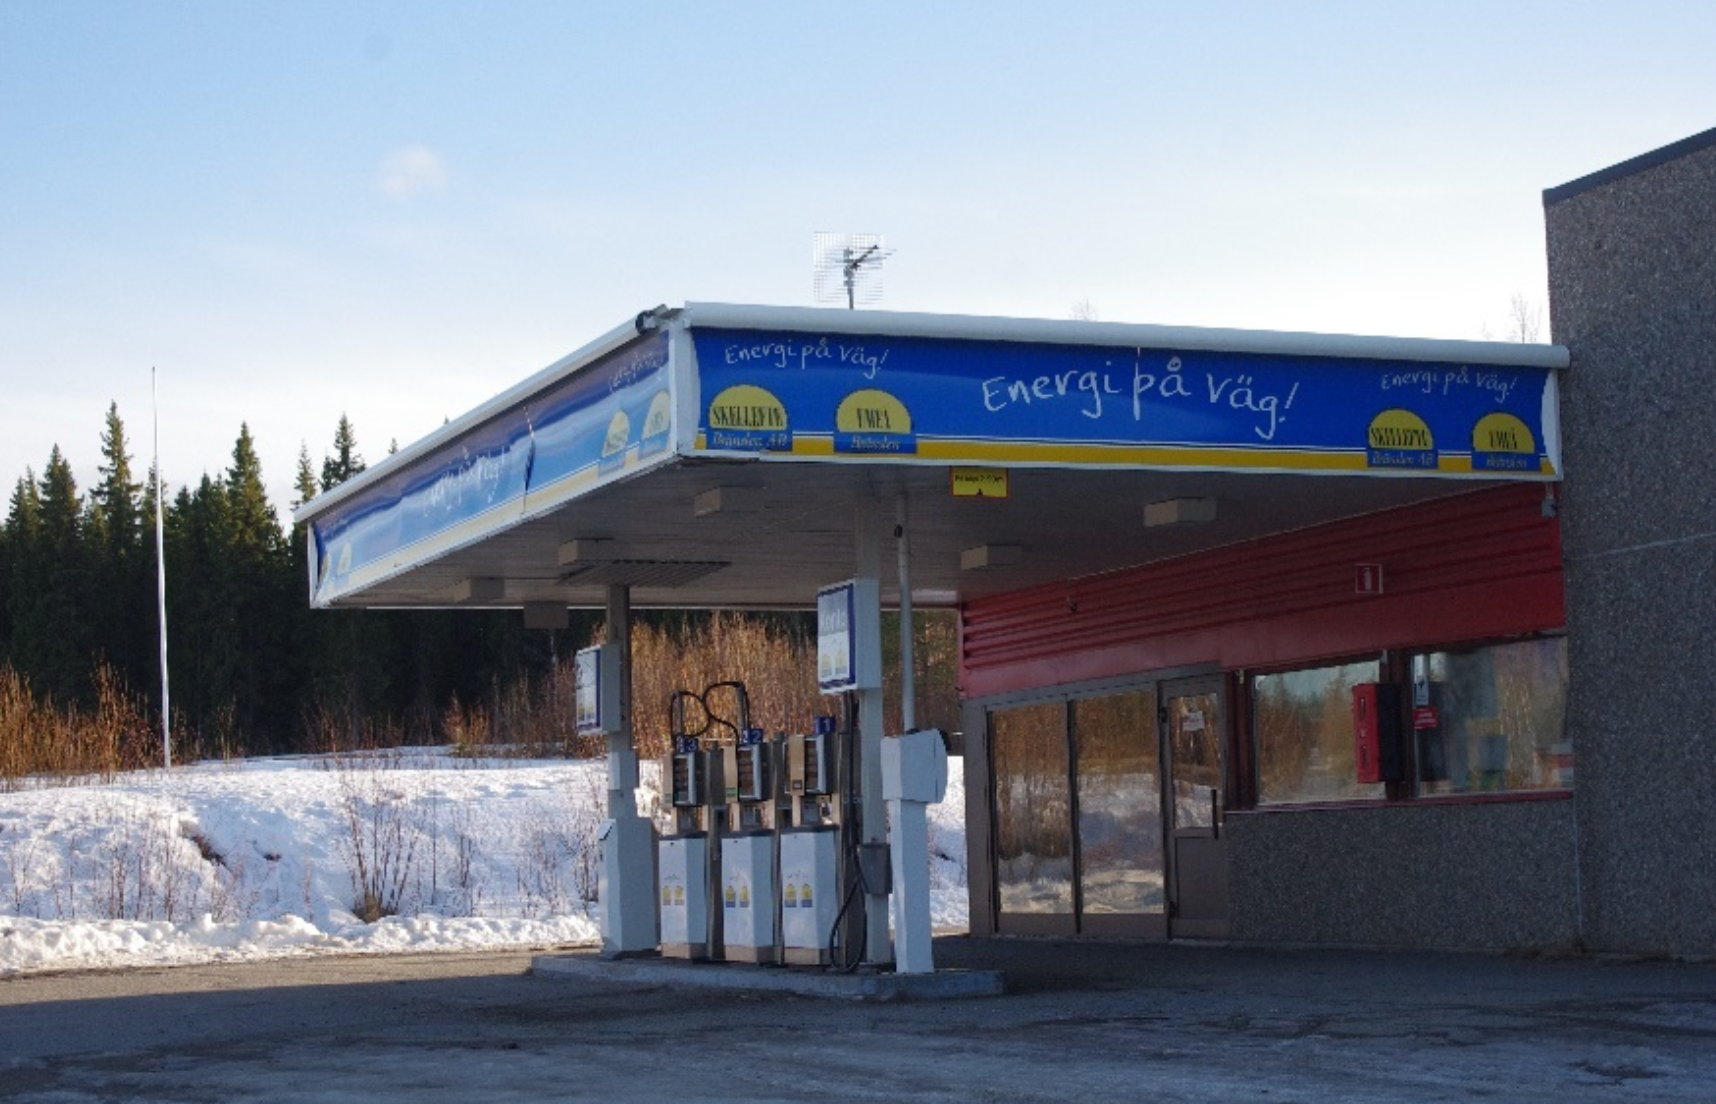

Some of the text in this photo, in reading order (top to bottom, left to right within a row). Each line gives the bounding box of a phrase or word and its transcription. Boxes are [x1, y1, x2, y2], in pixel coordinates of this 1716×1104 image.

[725, 338, 797, 368] Energi
[801, 337, 832, 370] på
[982, 360, 1122, 419] Energi
[1133, 355, 1192, 421] på
[1381, 369, 1438, 394] Energi
[1443, 365, 1469, 396] på
[752, 729, 762, 743] 2
[823, 720, 831, 733] 1
[688, 737, 698, 751] 3
